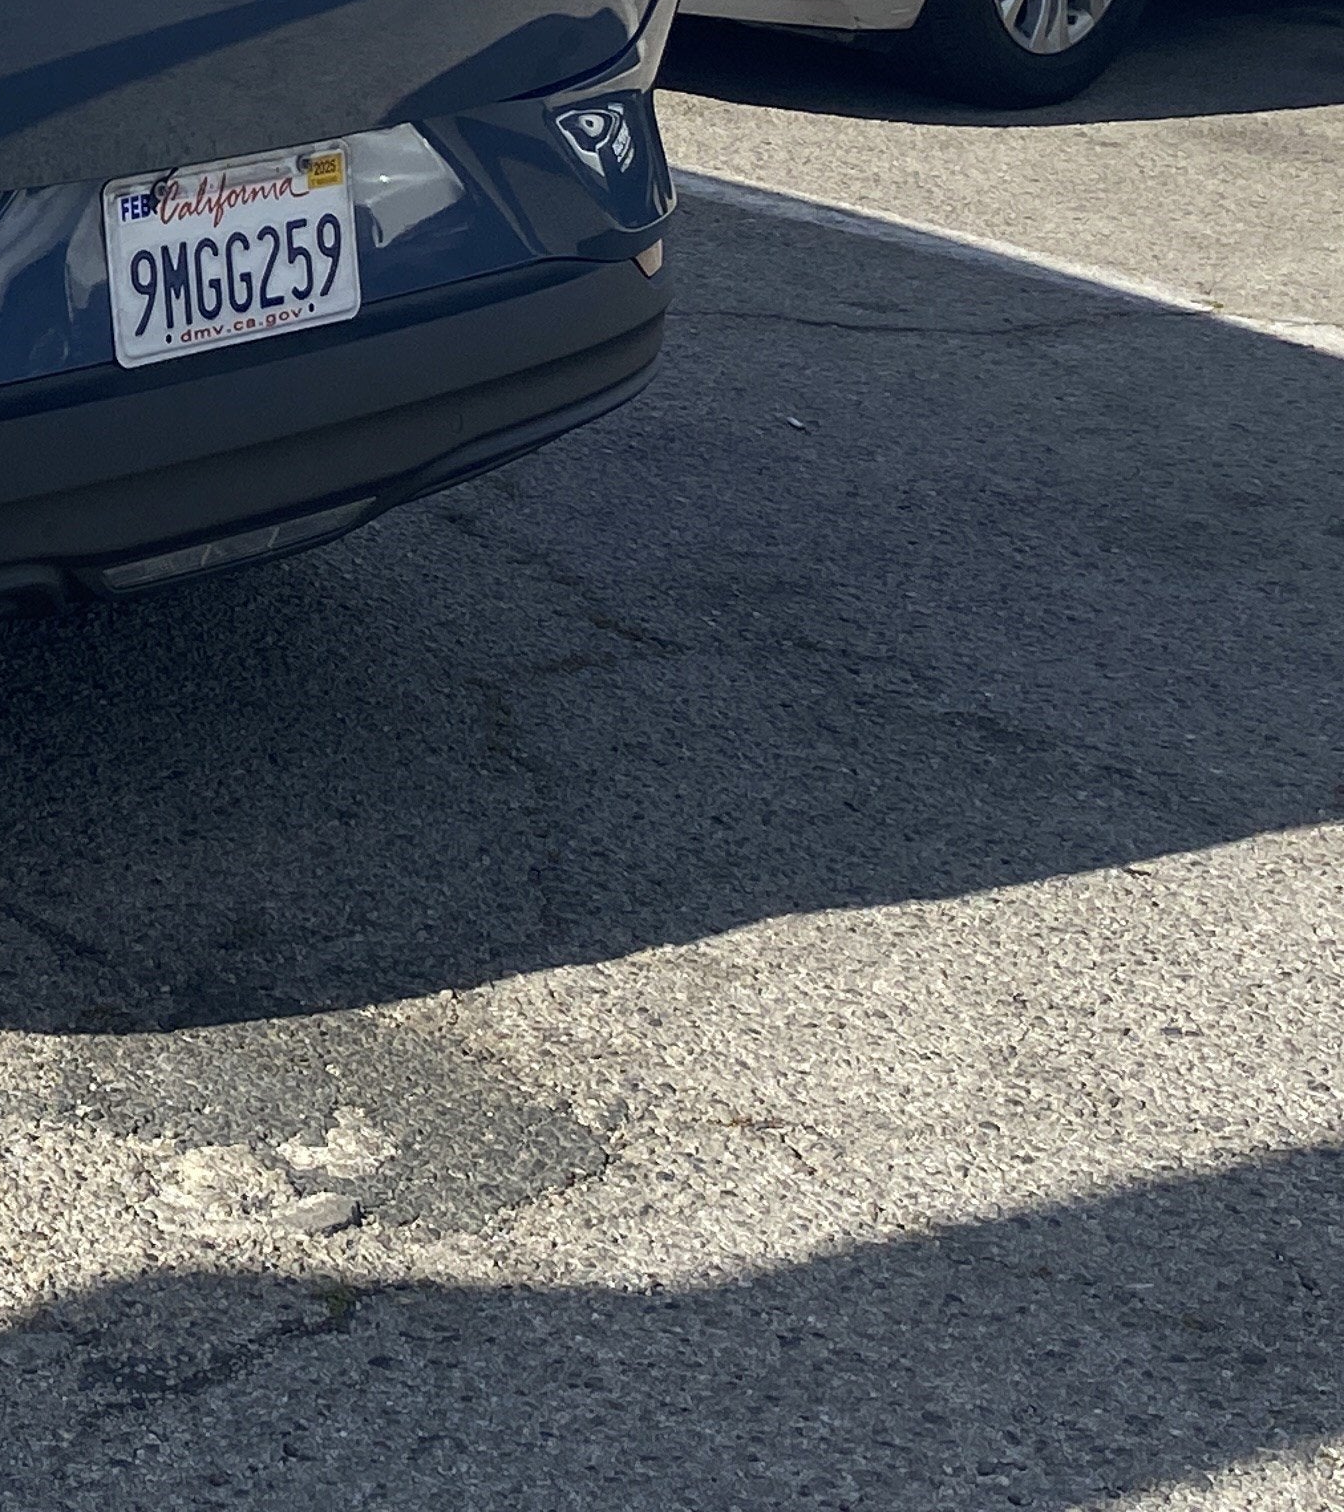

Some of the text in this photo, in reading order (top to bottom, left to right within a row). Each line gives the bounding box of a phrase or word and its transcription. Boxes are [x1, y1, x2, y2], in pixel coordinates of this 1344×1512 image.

[313, 158, 337, 176] 2025
[120, 172, 310, 228] FEB California
[130, 212, 341, 337] 9MGG259
[180, 307, 303, 343] dmv.ca.gov
